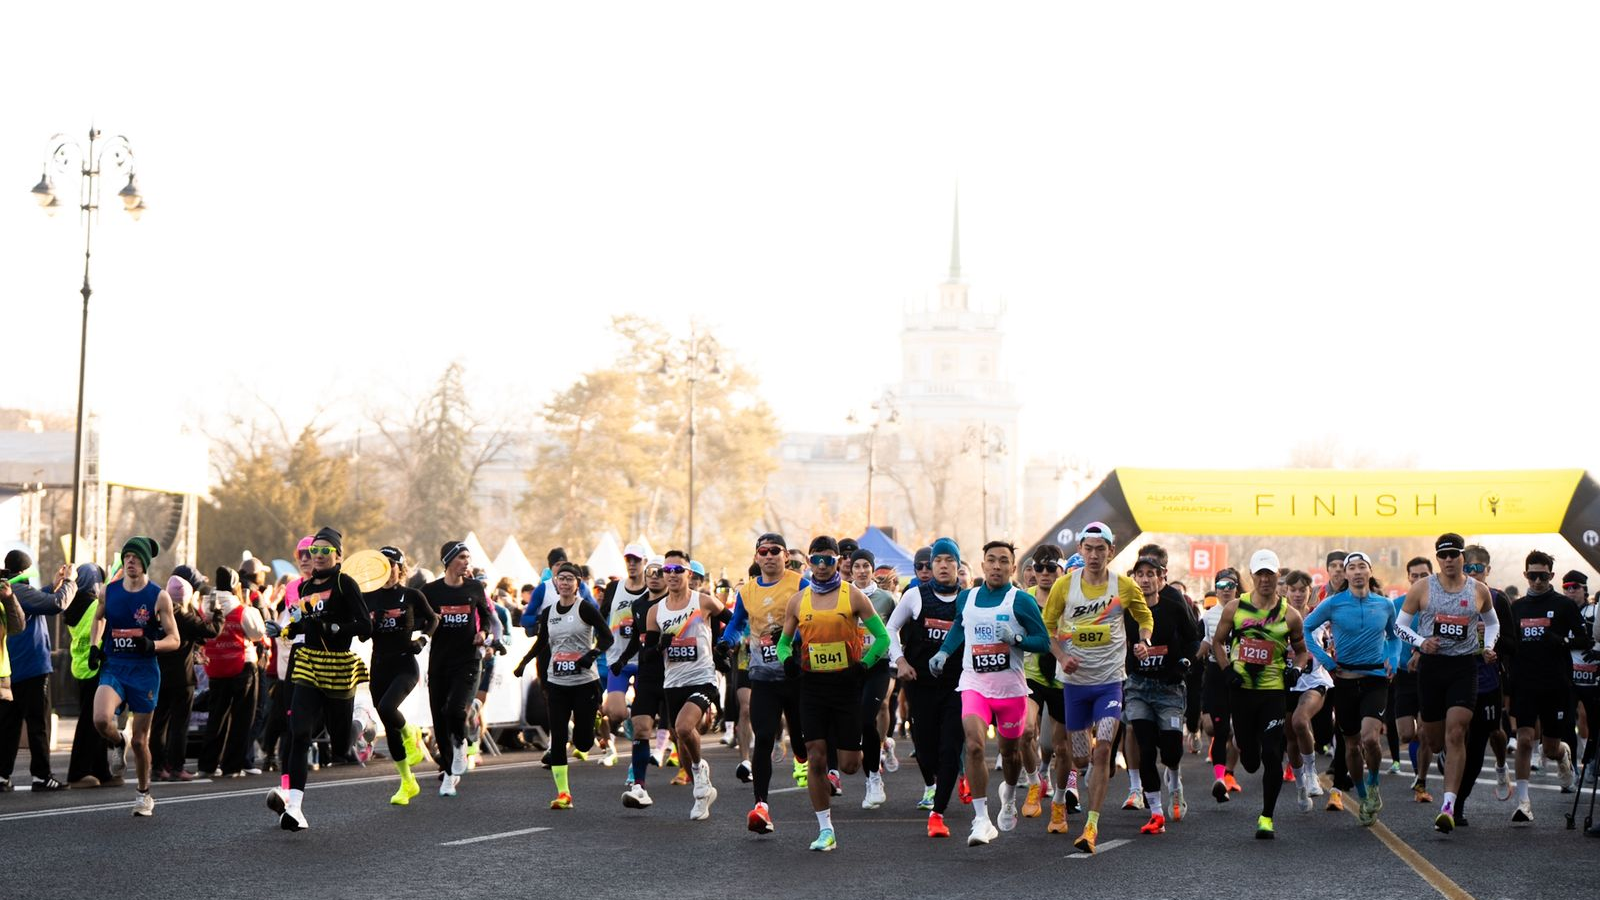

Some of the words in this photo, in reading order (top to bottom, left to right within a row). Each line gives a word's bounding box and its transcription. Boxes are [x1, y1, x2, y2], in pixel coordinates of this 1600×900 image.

[1162, 505, 1233, 513] MARATHON
[1255, 494, 1437, 516] FINISH
[1193, 549, 1211, 570] B
[443, 613, 468, 623] 1482
[1439, 624, 1463, 635] 865
[1524, 626, 1545, 637] 863
[1079, 632, 1104, 642] 887
[113, 638, 137, 648] 102
[668, 646, 696, 657] 2583
[1243, 646, 1268, 659] 1218
[814, 652, 842, 664] 1841
[975, 653, 1006, 667] 1336
[556, 661, 576, 671] 798
[1484, 705, 1496, 720] 11
